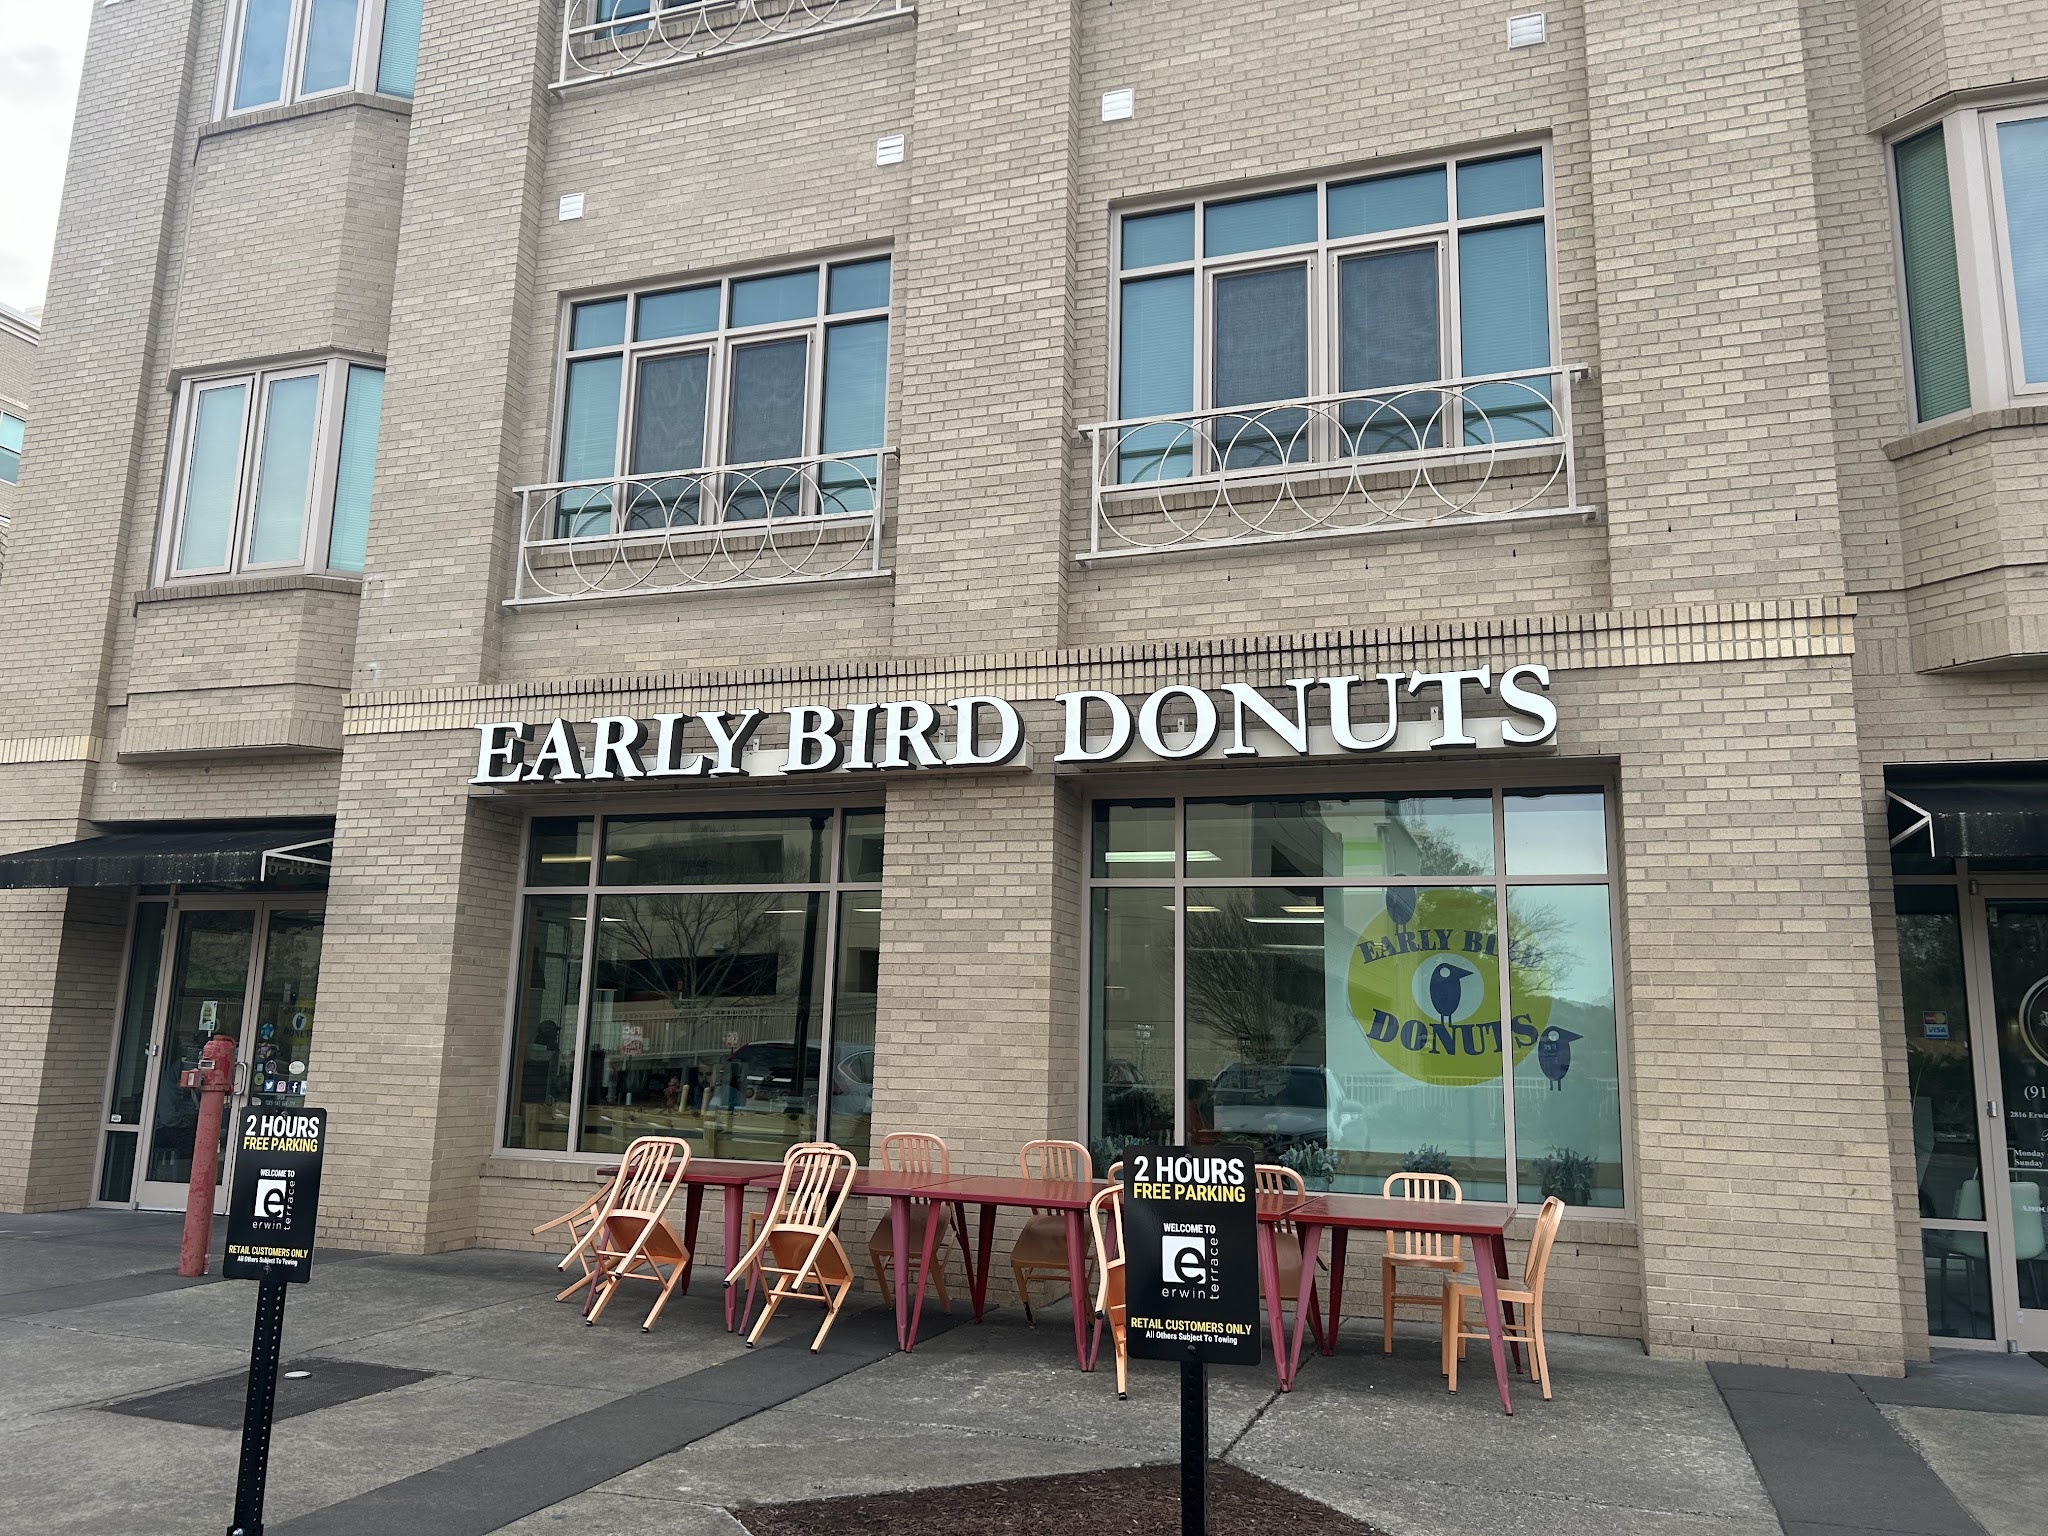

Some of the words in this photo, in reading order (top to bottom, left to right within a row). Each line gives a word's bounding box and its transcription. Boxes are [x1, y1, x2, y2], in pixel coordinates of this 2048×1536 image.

[467, 707, 764, 786] EARLY
[779, 695, 1029, 774] BIRD
[1054, 663, 1558, 764] DONUTS
[1357, 928, 1453, 964] EARLY
[1367, 1008, 1539, 1056] DONUTS
[246, 1114, 258, 1137] 2
[261, 1115, 320, 1139] HOURS
[243, 1137, 270, 1151] FREE
[271, 1138, 319, 1153] PARKING
[2014, 1149, 2045, 1159] Monday
[1134, 1156, 1149, 1182] 2
[1156, 1156, 1245, 1185] HOURS
[2014, 1159, 2044, 1168] Sunday
[260, 1168, 287, 1178] WELCOME
[287, 1169, 295, 1178] TO
[1133, 1182, 1171, 1200] FREE
[1175, 1184, 1246, 1203] PARKING
[284, 1181, 296, 1231] terrace
[252, 1220, 282, 1230] erwin
[1163, 1222, 1204, 1234] WELCOME
[1204, 1223, 1216, 1234] TO
[229, 1245, 251, 1255] RETAIL
[252, 1246, 290, 1257] CUSTOMERS
[291, 1248, 309, 1259] ONLY
[244, 1256, 259, 1264] Others
[259, 1257, 275, 1266] Subject
[275, 1257, 282, 1265] To
[282, 1258, 298, 1267] Towing
[1210, 1237, 1220, 1300] terrace
[1161, 1287, 1206, 1300] erwin
[1131, 1318, 1164, 1330] RETAIL
[1165, 1319, 1224, 1334] CUSTOMERS
[1226, 1323, 1253, 1335] ONLY
[1146, 1330, 1155, 1339] All
[1156, 1331, 1178, 1340] Others
[1178, 1332, 1203, 1343] Subject
[1204, 1334, 1213, 1343] To
[1214, 1334, 1238, 1345] Towing
